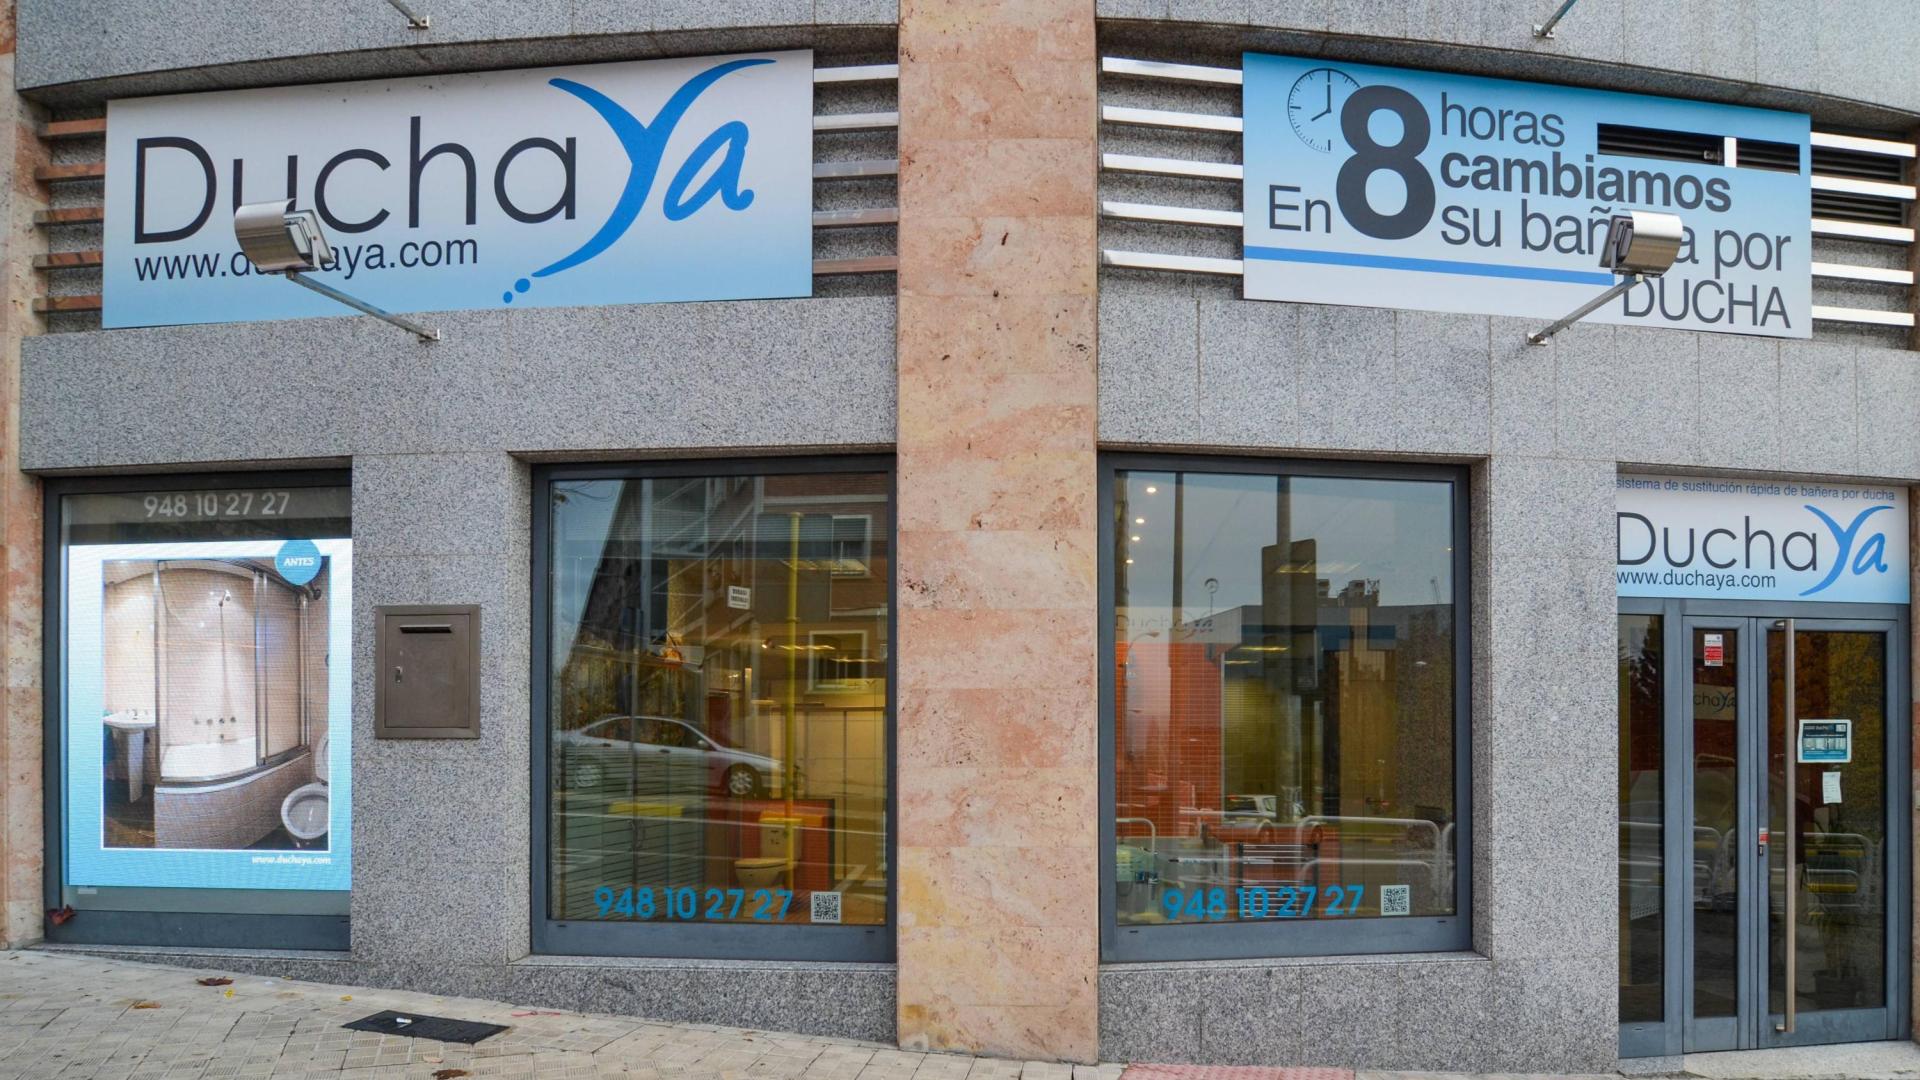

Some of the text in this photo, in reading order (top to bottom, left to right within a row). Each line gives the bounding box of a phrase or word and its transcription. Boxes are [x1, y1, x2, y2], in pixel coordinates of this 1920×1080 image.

[1269, 84, 1565, 240] En 8 horas
[1440, 151, 1732, 213] cambiamos
[1440, 199, 1791, 280] su baña por
[1623, 274, 1791, 329] DUCHA
[143, 492, 290, 518] 948 10 27 27
[1616, 477, 1895, 501] sistema de sustitución rápida de bañera por ducha
[282, 556, 315, 567] ANTES
[1616, 569, 1776, 591] www.duchaya.com
[594, 886, 793, 920] 948 10 27 27
[1163, 884, 1364, 920] 948 10 27 27
